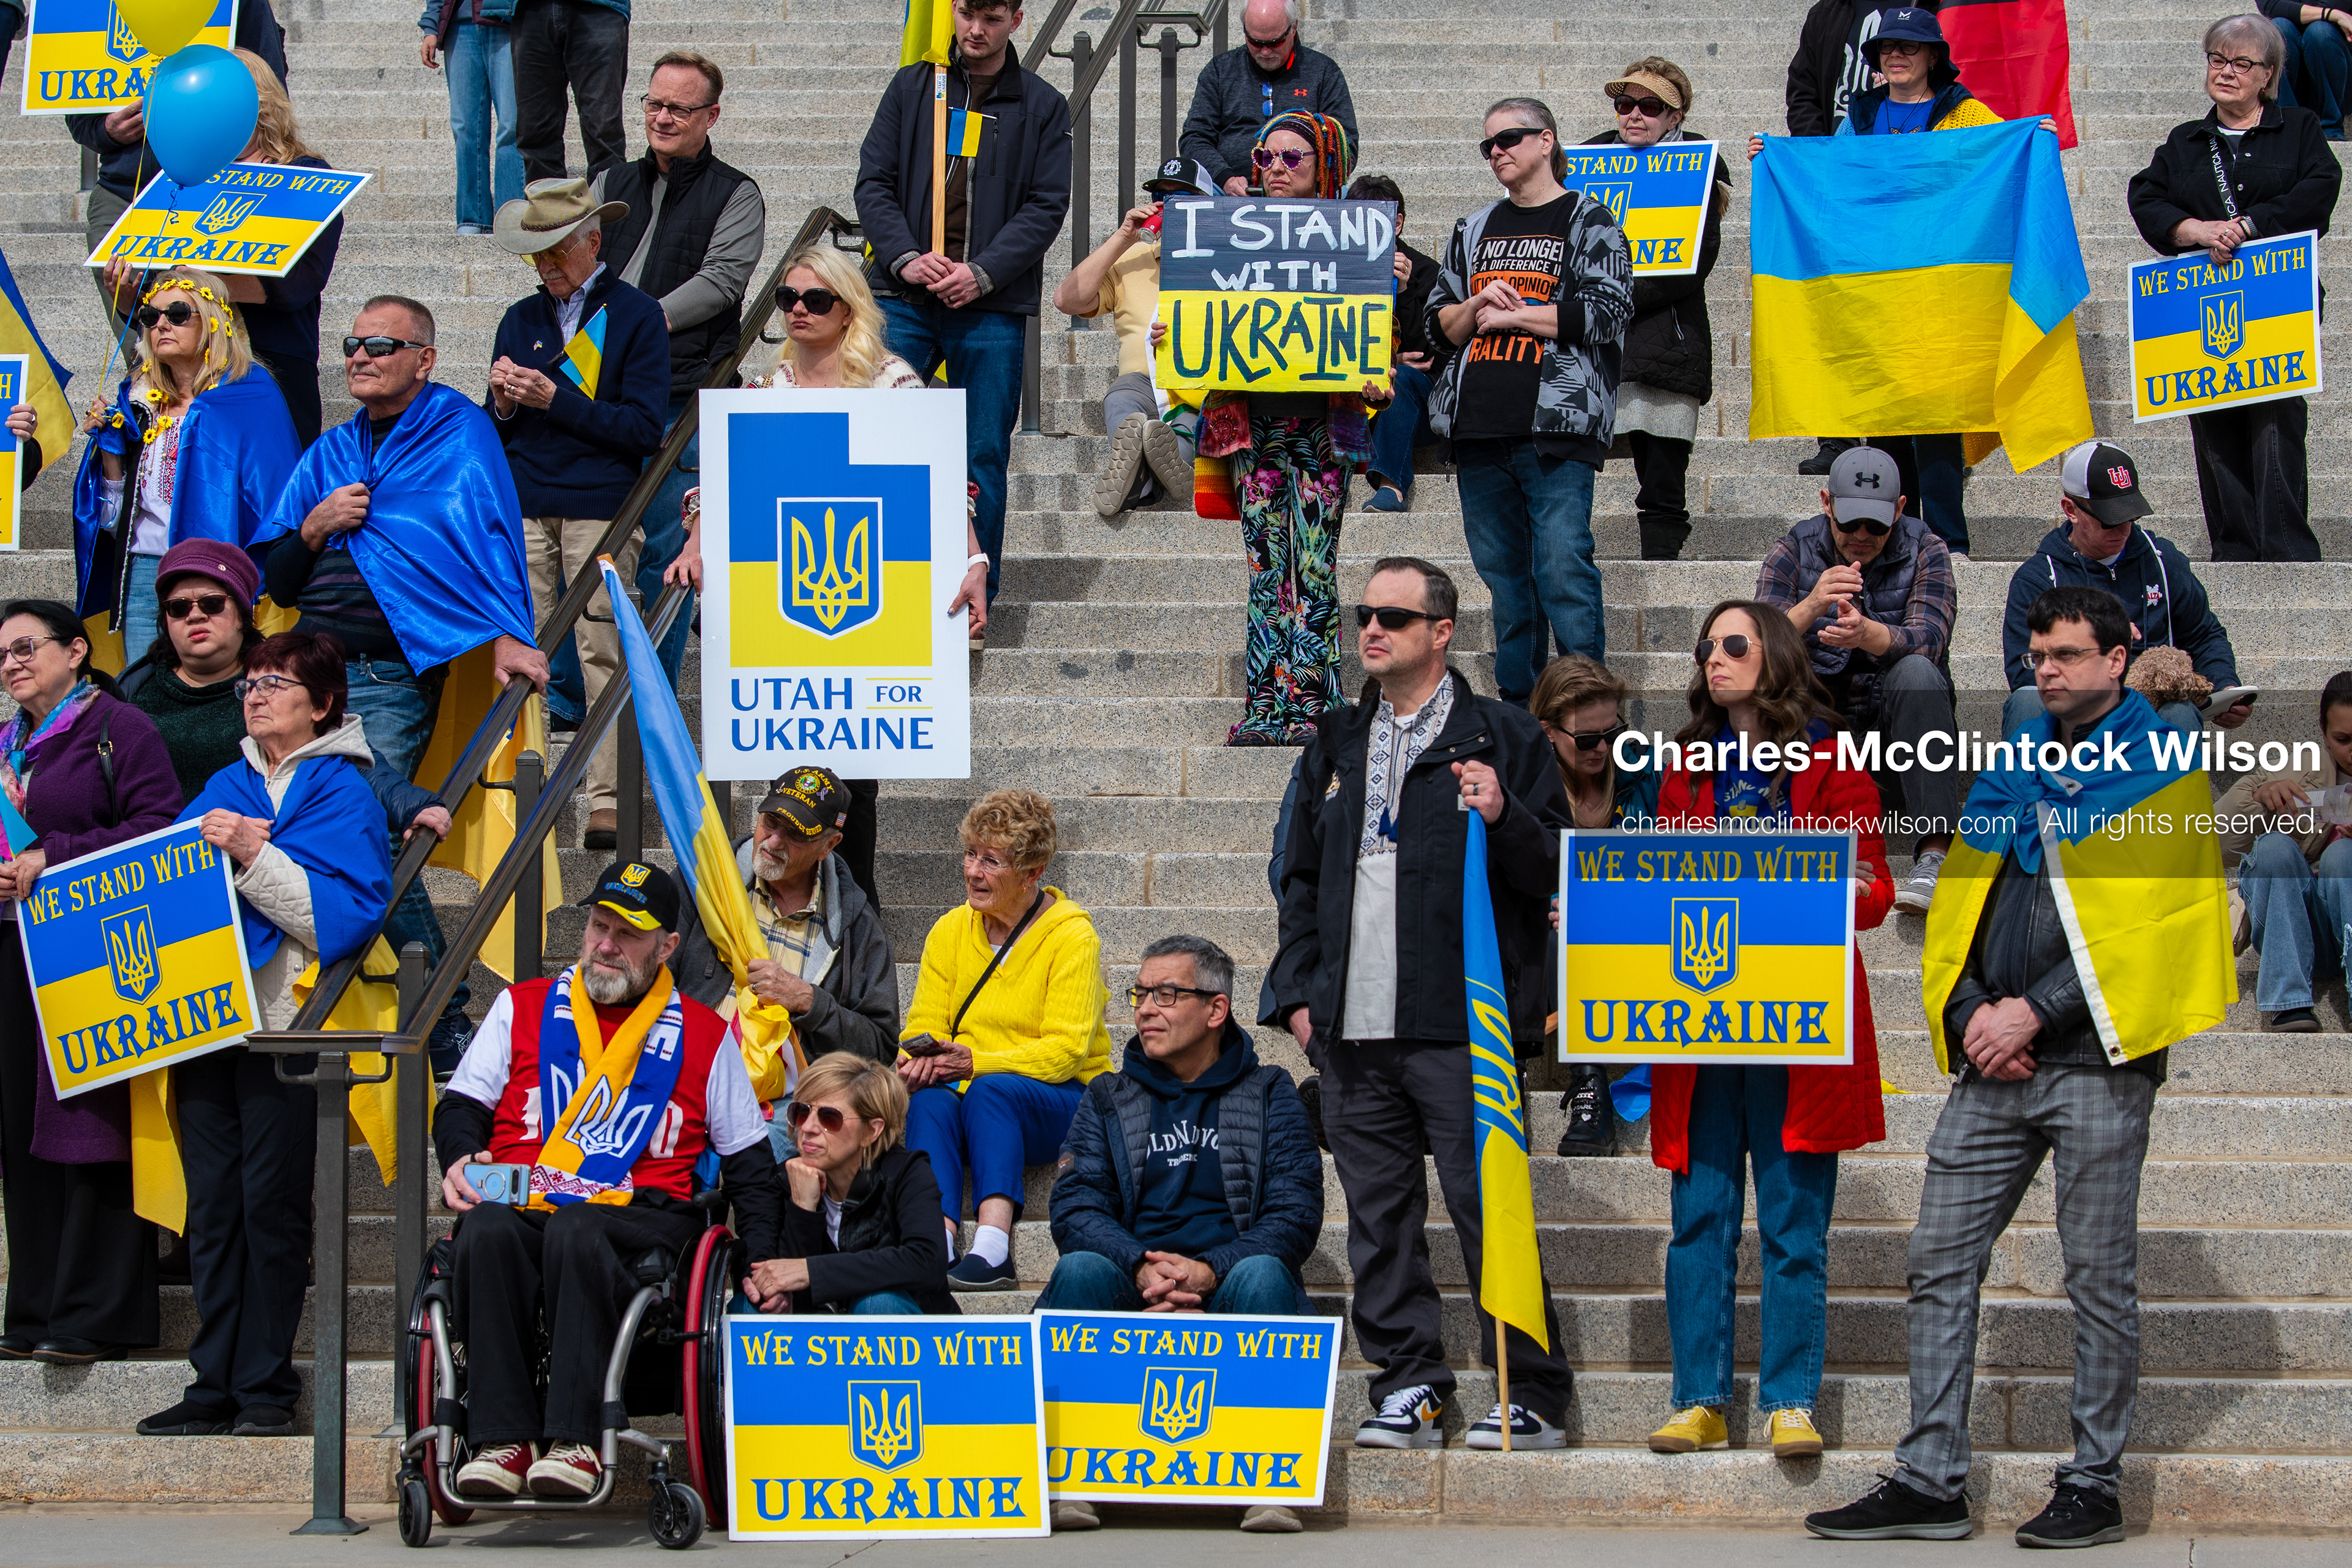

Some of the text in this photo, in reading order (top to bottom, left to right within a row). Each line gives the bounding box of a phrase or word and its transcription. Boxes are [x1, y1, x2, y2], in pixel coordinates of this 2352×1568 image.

[40, 68, 146, 102] UKRA
[1567, 150, 1705, 175] STAND WITH
[2212, 151, 2229, 193] NAUTICA
[288, 175, 352, 195] WITH
[1171, 201, 1393, 262] I STAND
[1482, 239, 1507, 260] NO
[111, 235, 290, 265] UKRAINE
[1480, 261, 1487, 272] A
[1490, 258, 1551, 273] DIFFERENCE
[1211, 260, 1337, 292] WITH
[2138, 247, 2306, 298] WE STAND WITH
[1172, 296, 1387, 383] UKRAINE
[2144, 350, 2309, 407] UKRAINE
[730, 677, 922, 711] UTAH FOR
[730, 716, 934, 752] UKRAINE
[782, 787, 816, 809] VETERAN
[812, 769, 834, 792] ARMY
[776, 807, 823, 835] PROUDLY SERVED
[1577, 843, 1839, 882] WE STAND WITH
[26, 839, 216, 926] WE STAND WITH
[604, 881, 647, 905] UKRAINE
[58, 981, 243, 1074] UKRAINE
[1579, 999, 1831, 1048] UKRAINE
[741, 1329, 1022, 1366] WE STAND WITH
[1049, 1322, 1323, 1360] WE STAND WITH
[750, 1477, 1027, 1525] UKRAINE
